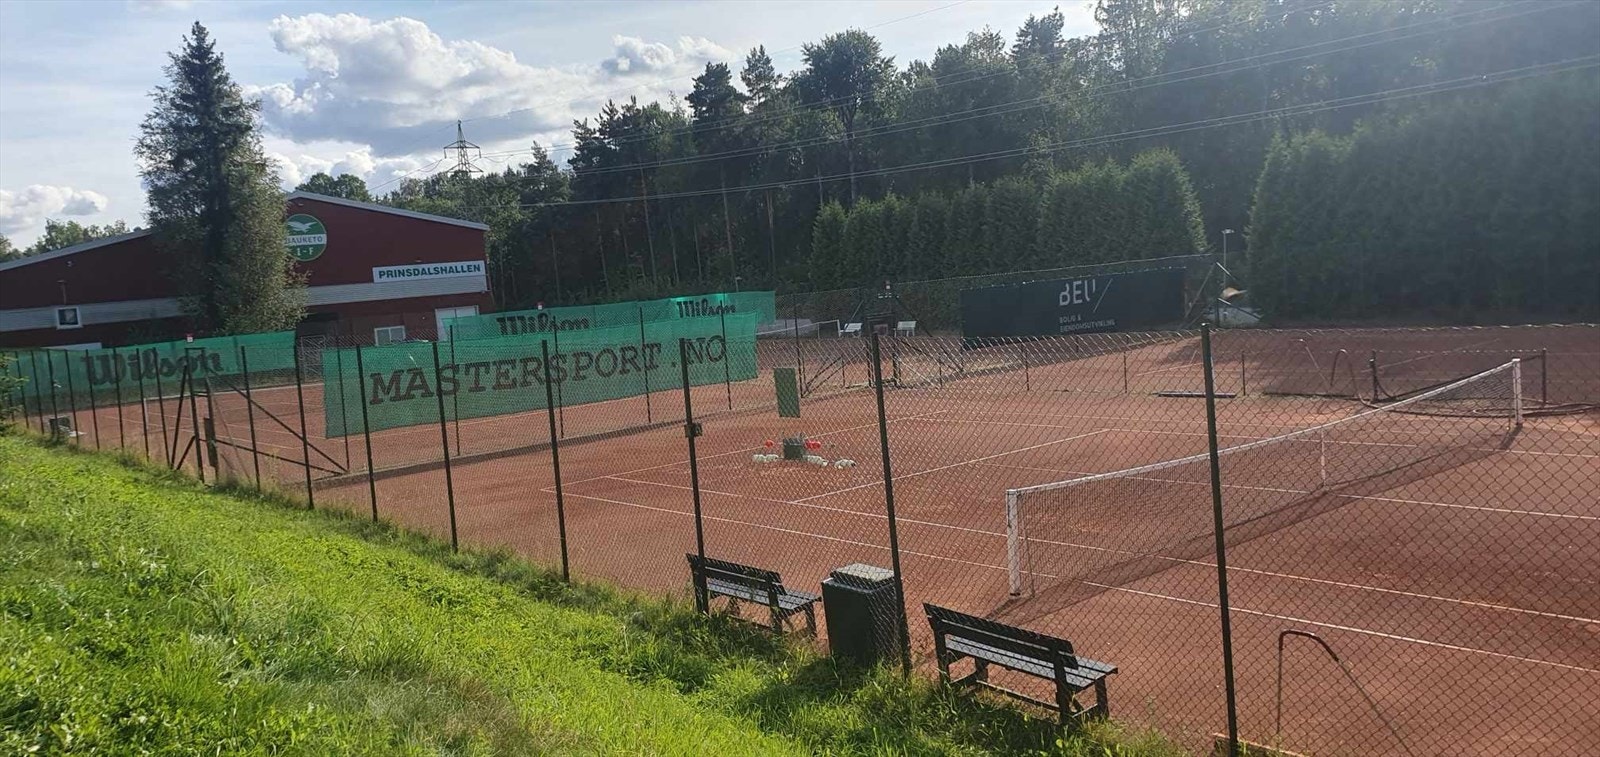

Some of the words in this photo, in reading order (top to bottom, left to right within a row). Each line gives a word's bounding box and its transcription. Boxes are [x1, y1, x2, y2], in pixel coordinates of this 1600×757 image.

[378, 263, 481, 279] PRINSDALSHALLEN
[677, 298, 737, 318] Wilson
[496, 311, 590, 335] Wilson
[81, 347, 224, 386] Wilson
